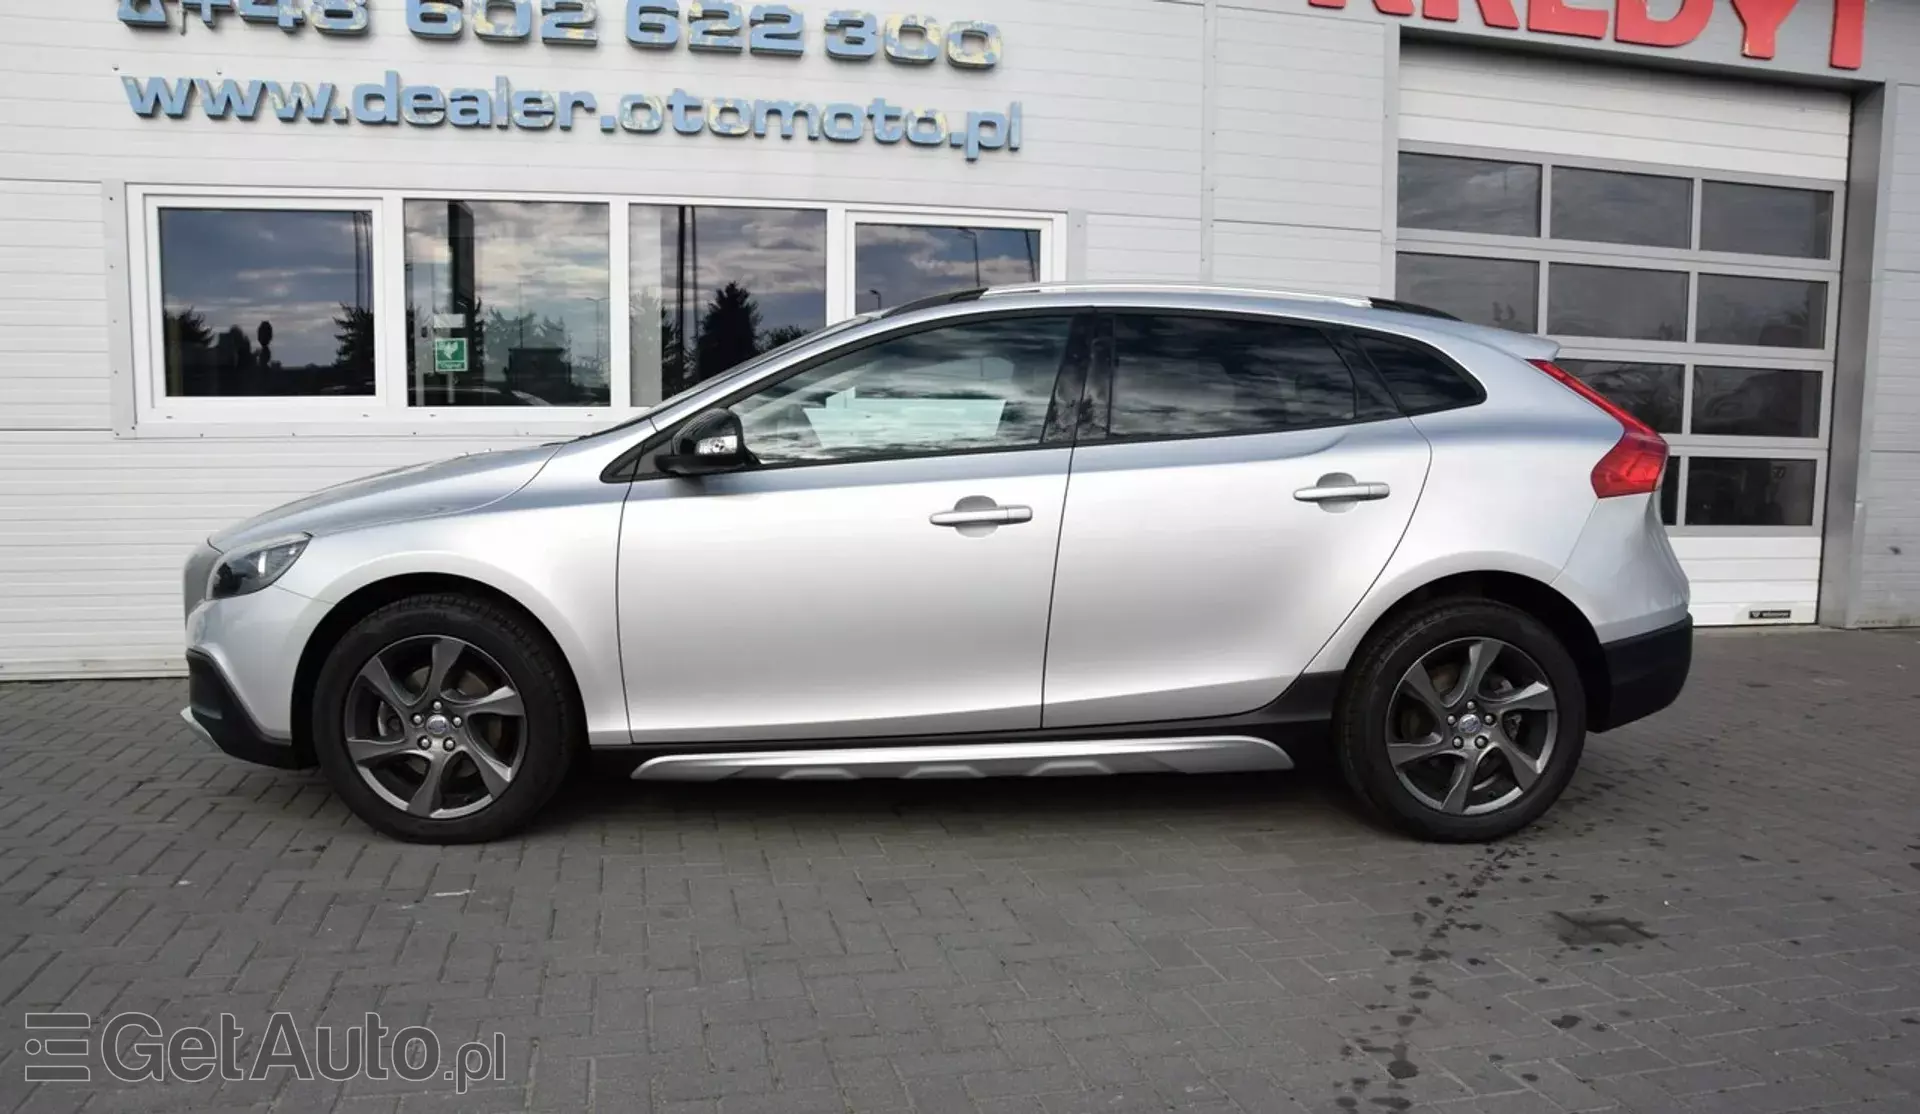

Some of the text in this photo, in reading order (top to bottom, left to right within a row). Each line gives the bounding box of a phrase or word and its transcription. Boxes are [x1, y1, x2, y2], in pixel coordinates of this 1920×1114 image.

[406, 0, 597, 44] 602
[625, 0, 804, 57] 622
[824, 9, 1003, 71] 300
[120, 70, 1022, 161] www.dealer.otomoto.pl
